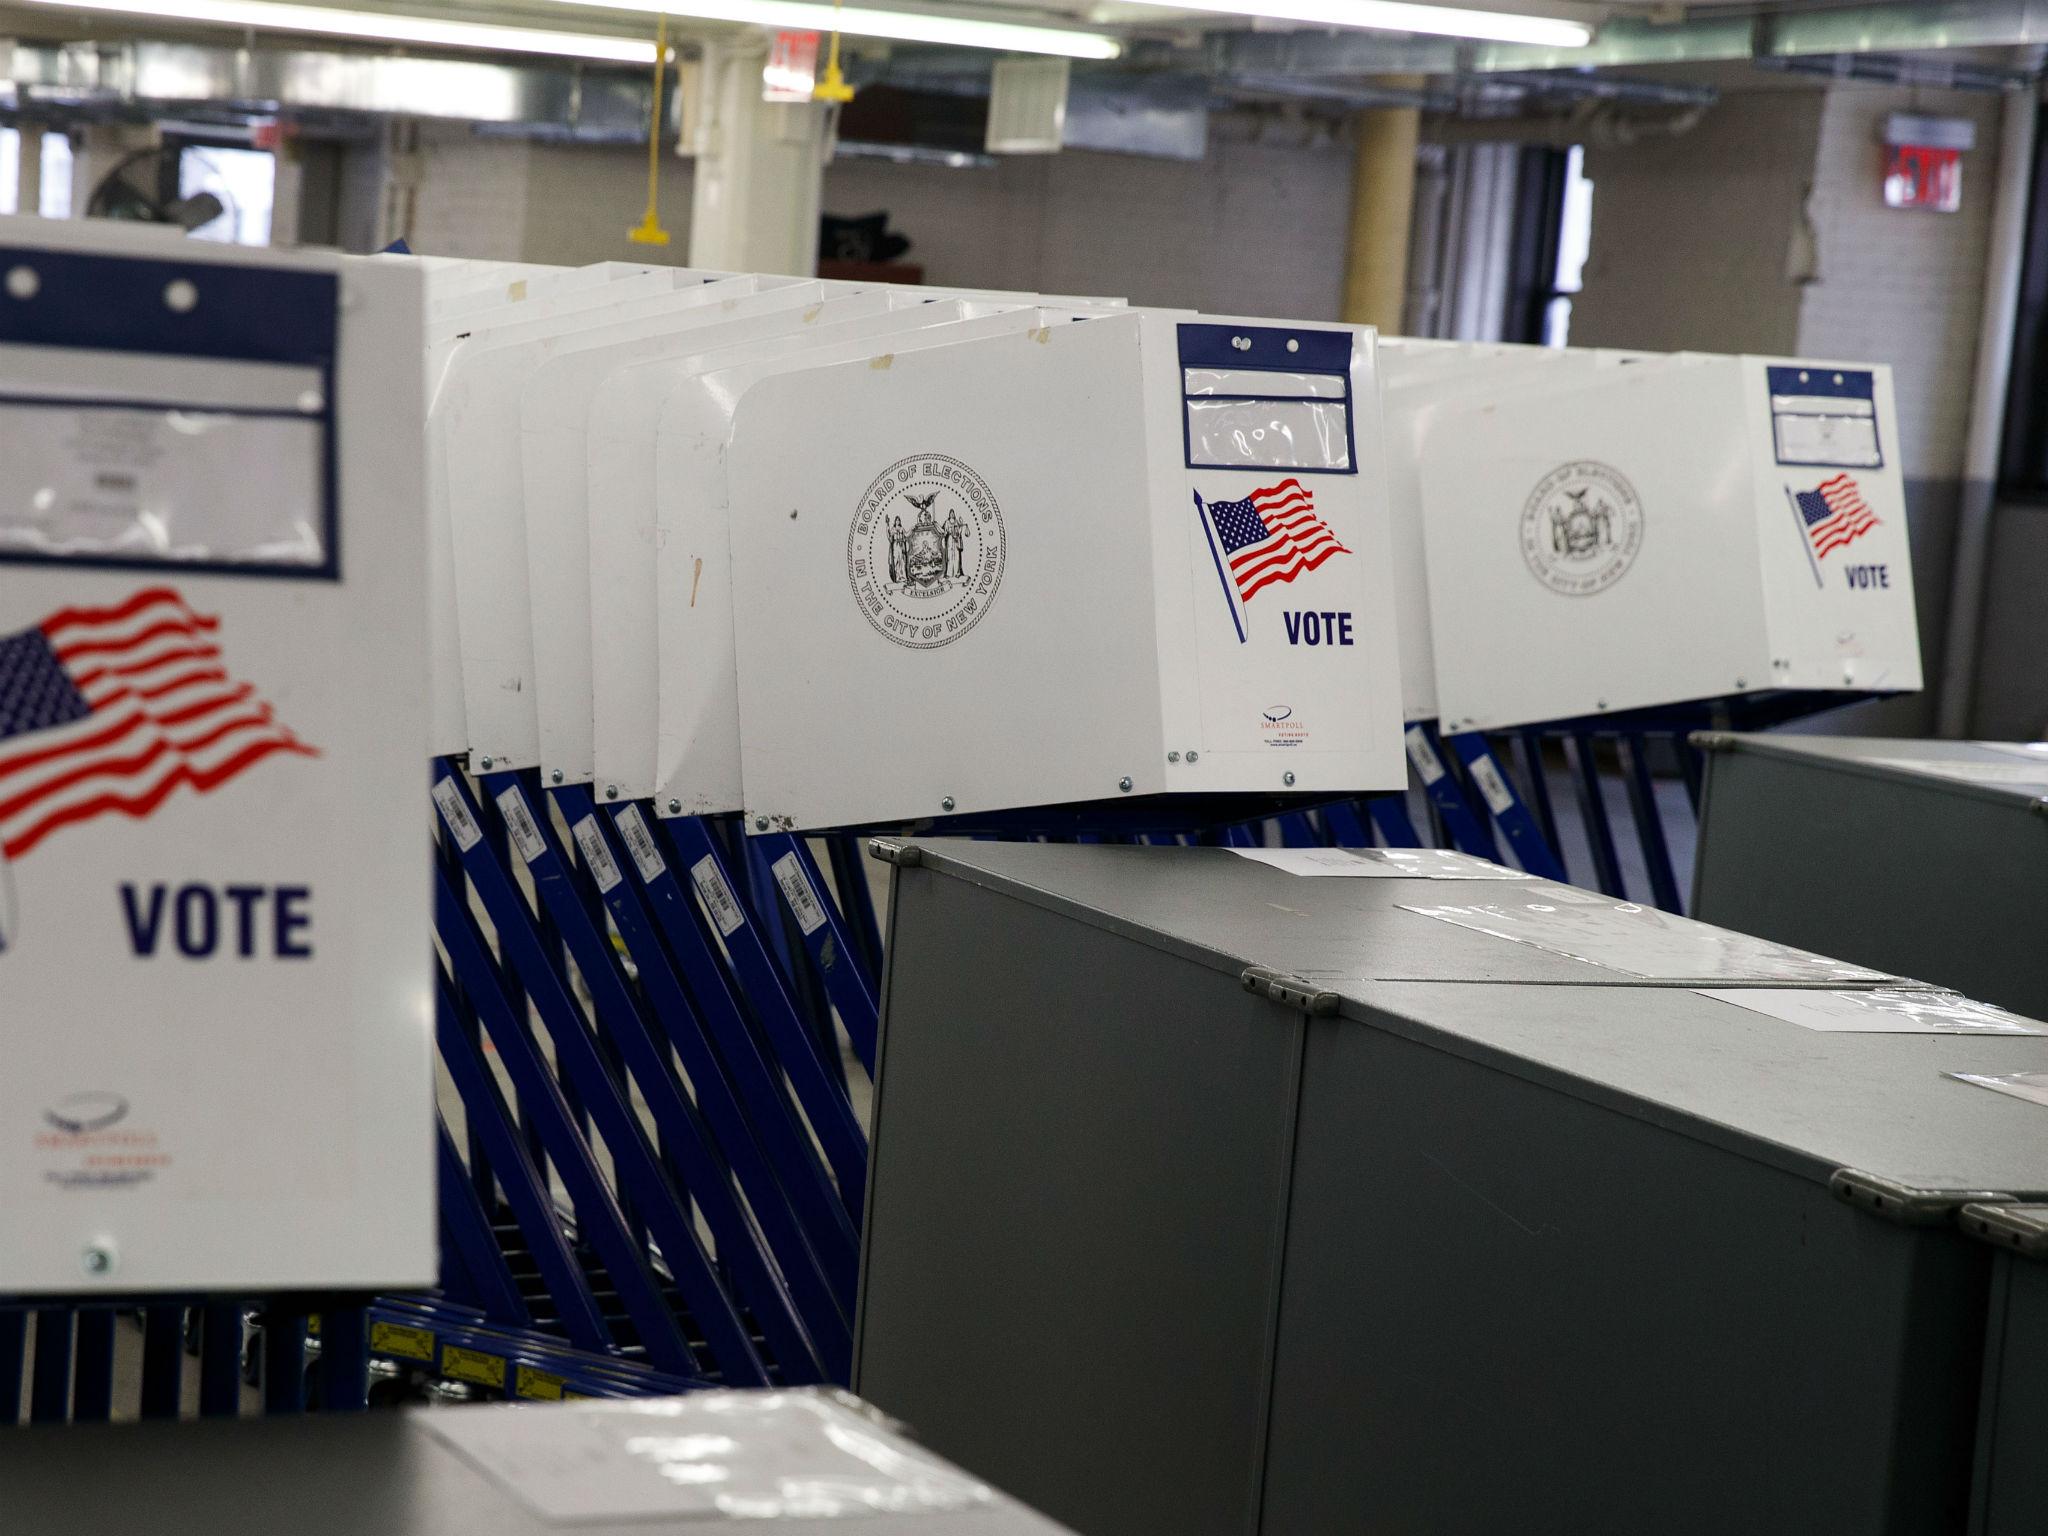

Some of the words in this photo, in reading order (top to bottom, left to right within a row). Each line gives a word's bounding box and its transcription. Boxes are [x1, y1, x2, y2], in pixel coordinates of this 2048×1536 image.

[857, 478, 895, 536] BOARD
[897, 464, 917, 483] OF
[923, 463, 993, 523] ELECTIONS
[855, 558, 868, 578] IN
[975, 546, 998, 597] YORK
[1844, 565, 1890, 590] VOTE
[861, 581, 884, 616] THE
[884, 615, 919, 639] CITY
[921, 624, 942, 639] OF
[946, 599, 979, 633] NEW
[1283, 611, 1354, 646] VOTE
[1260, 721, 1303, 729] SMARTPOLL
[117, 881, 315, 961] VOTE
